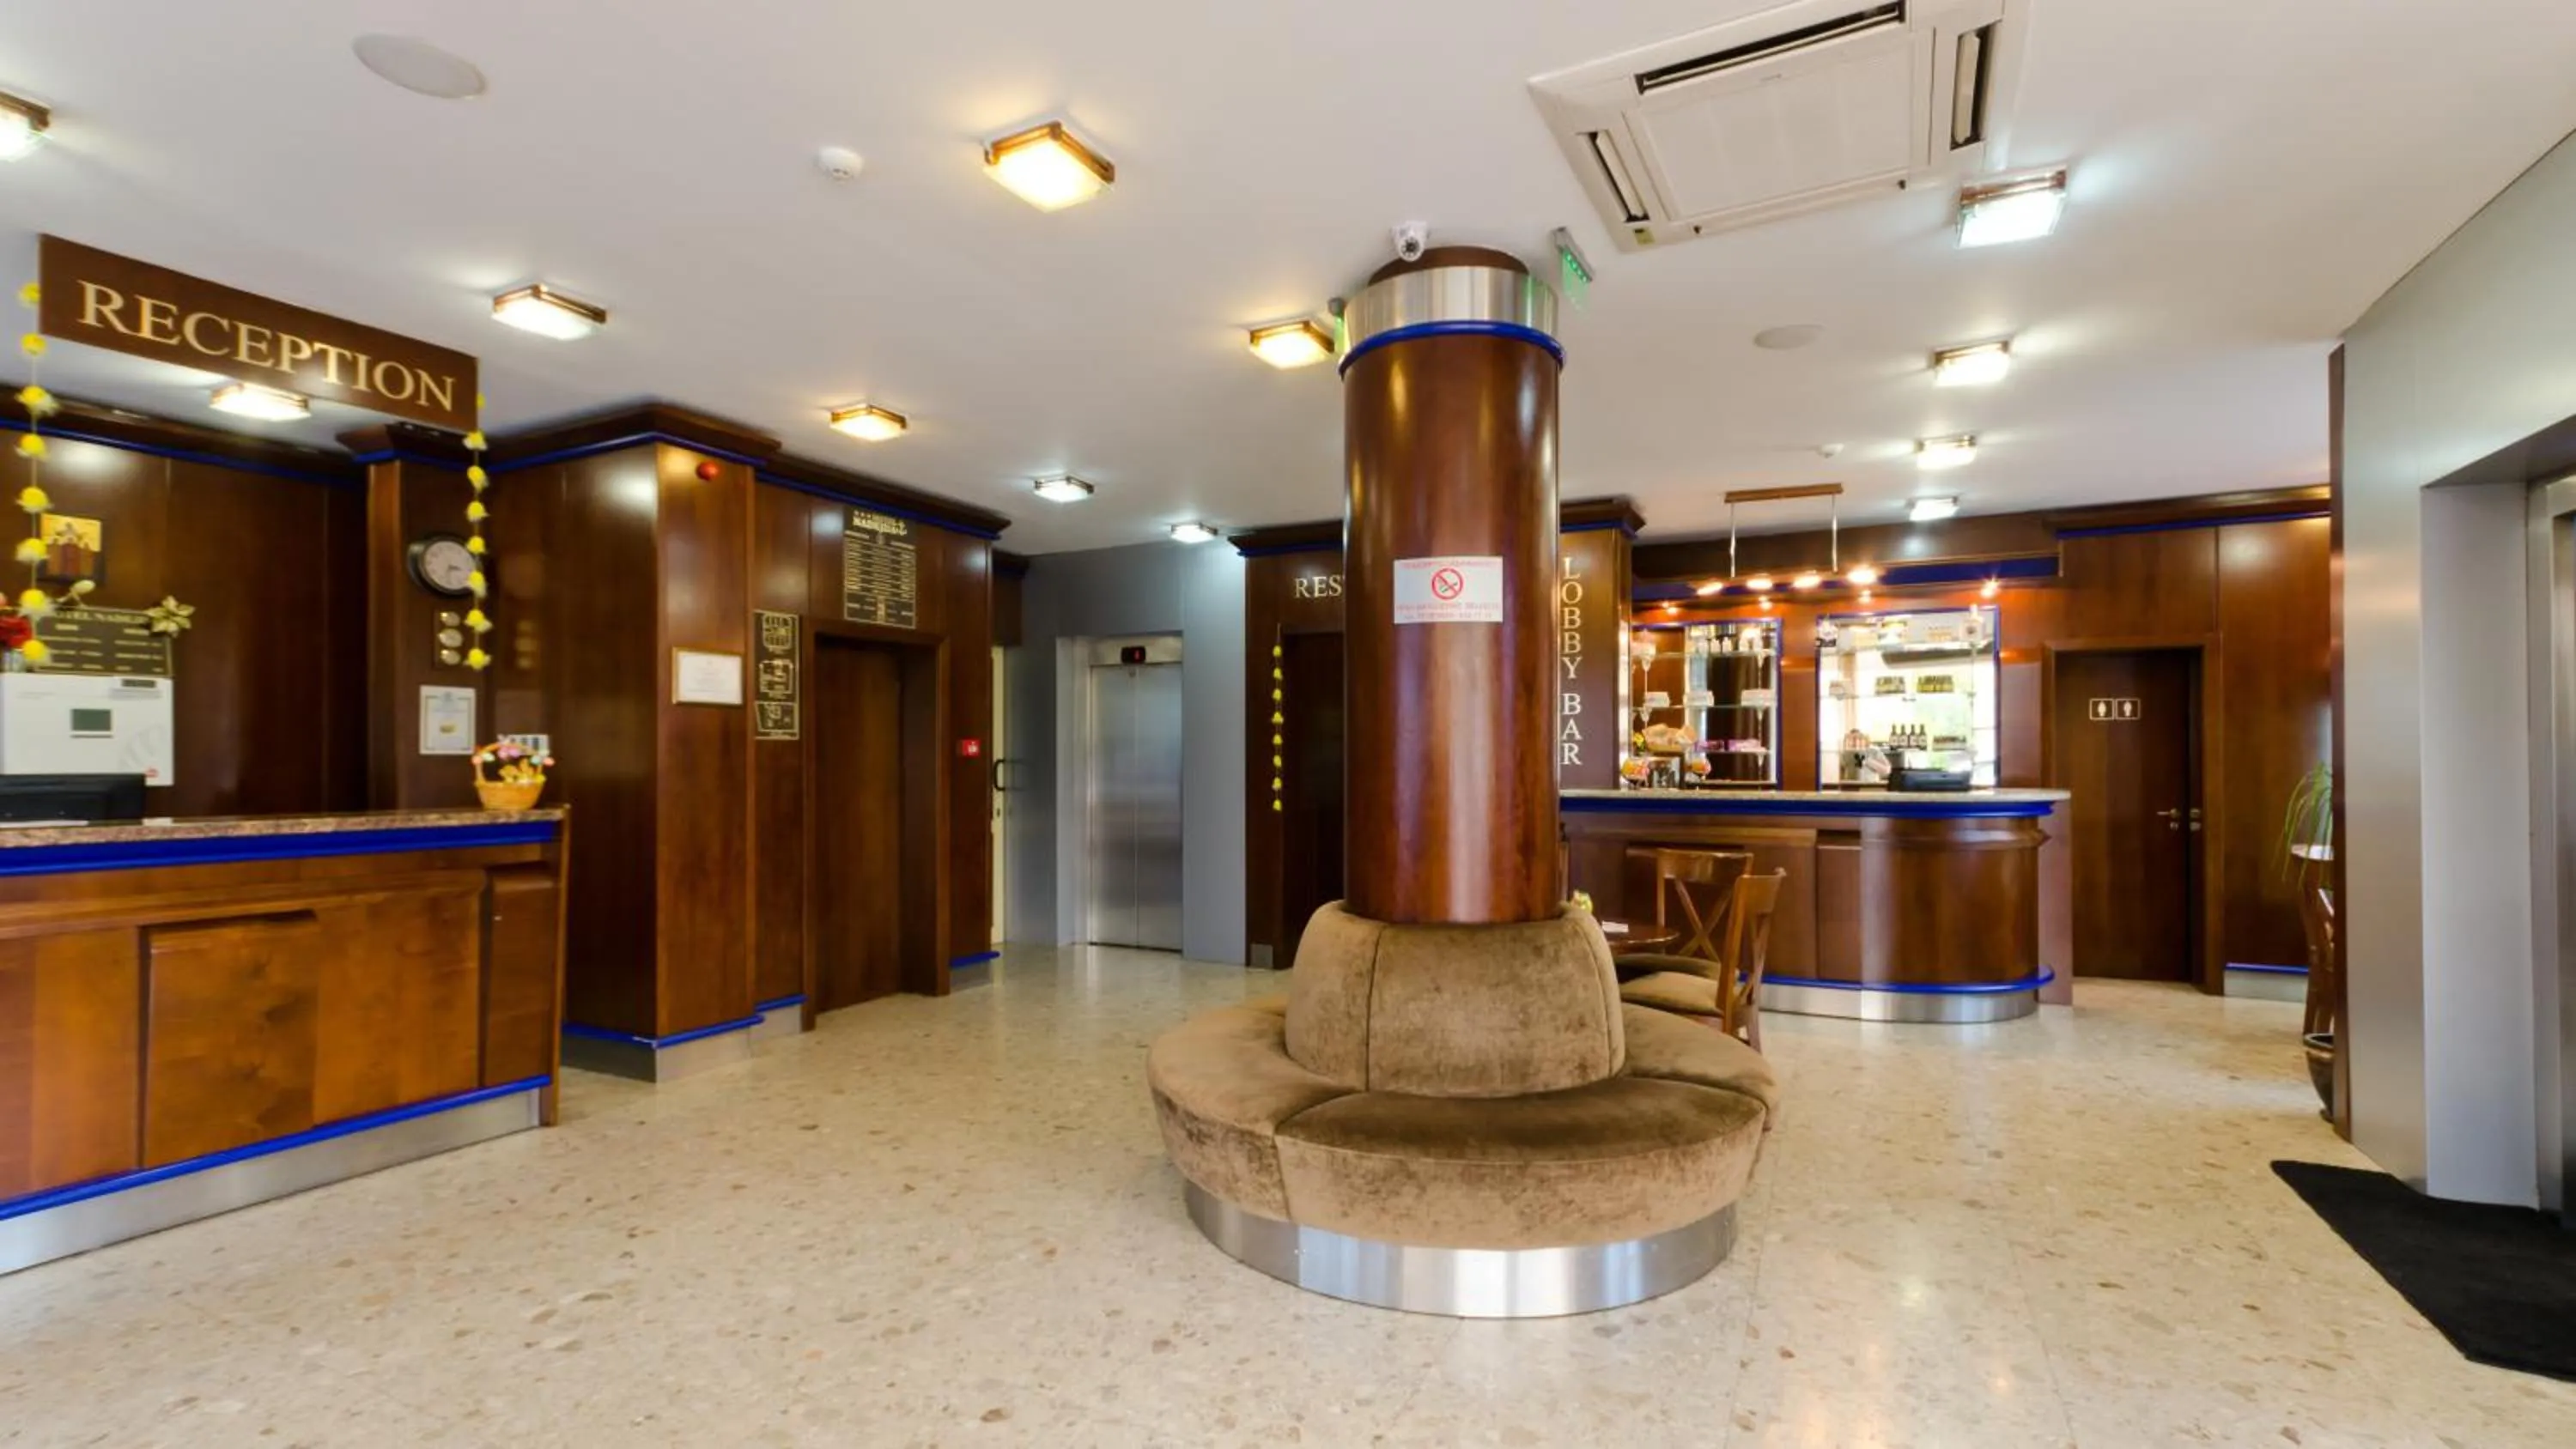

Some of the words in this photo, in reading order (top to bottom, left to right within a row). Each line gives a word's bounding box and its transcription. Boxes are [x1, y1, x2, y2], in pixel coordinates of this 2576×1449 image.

[77, 279, 454, 413] RECEPTION
[1294, 574, 1344, 598] RES
[1561, 556, 1583, 679] LOBBY
[1560, 693, 1583, 766] BAR
